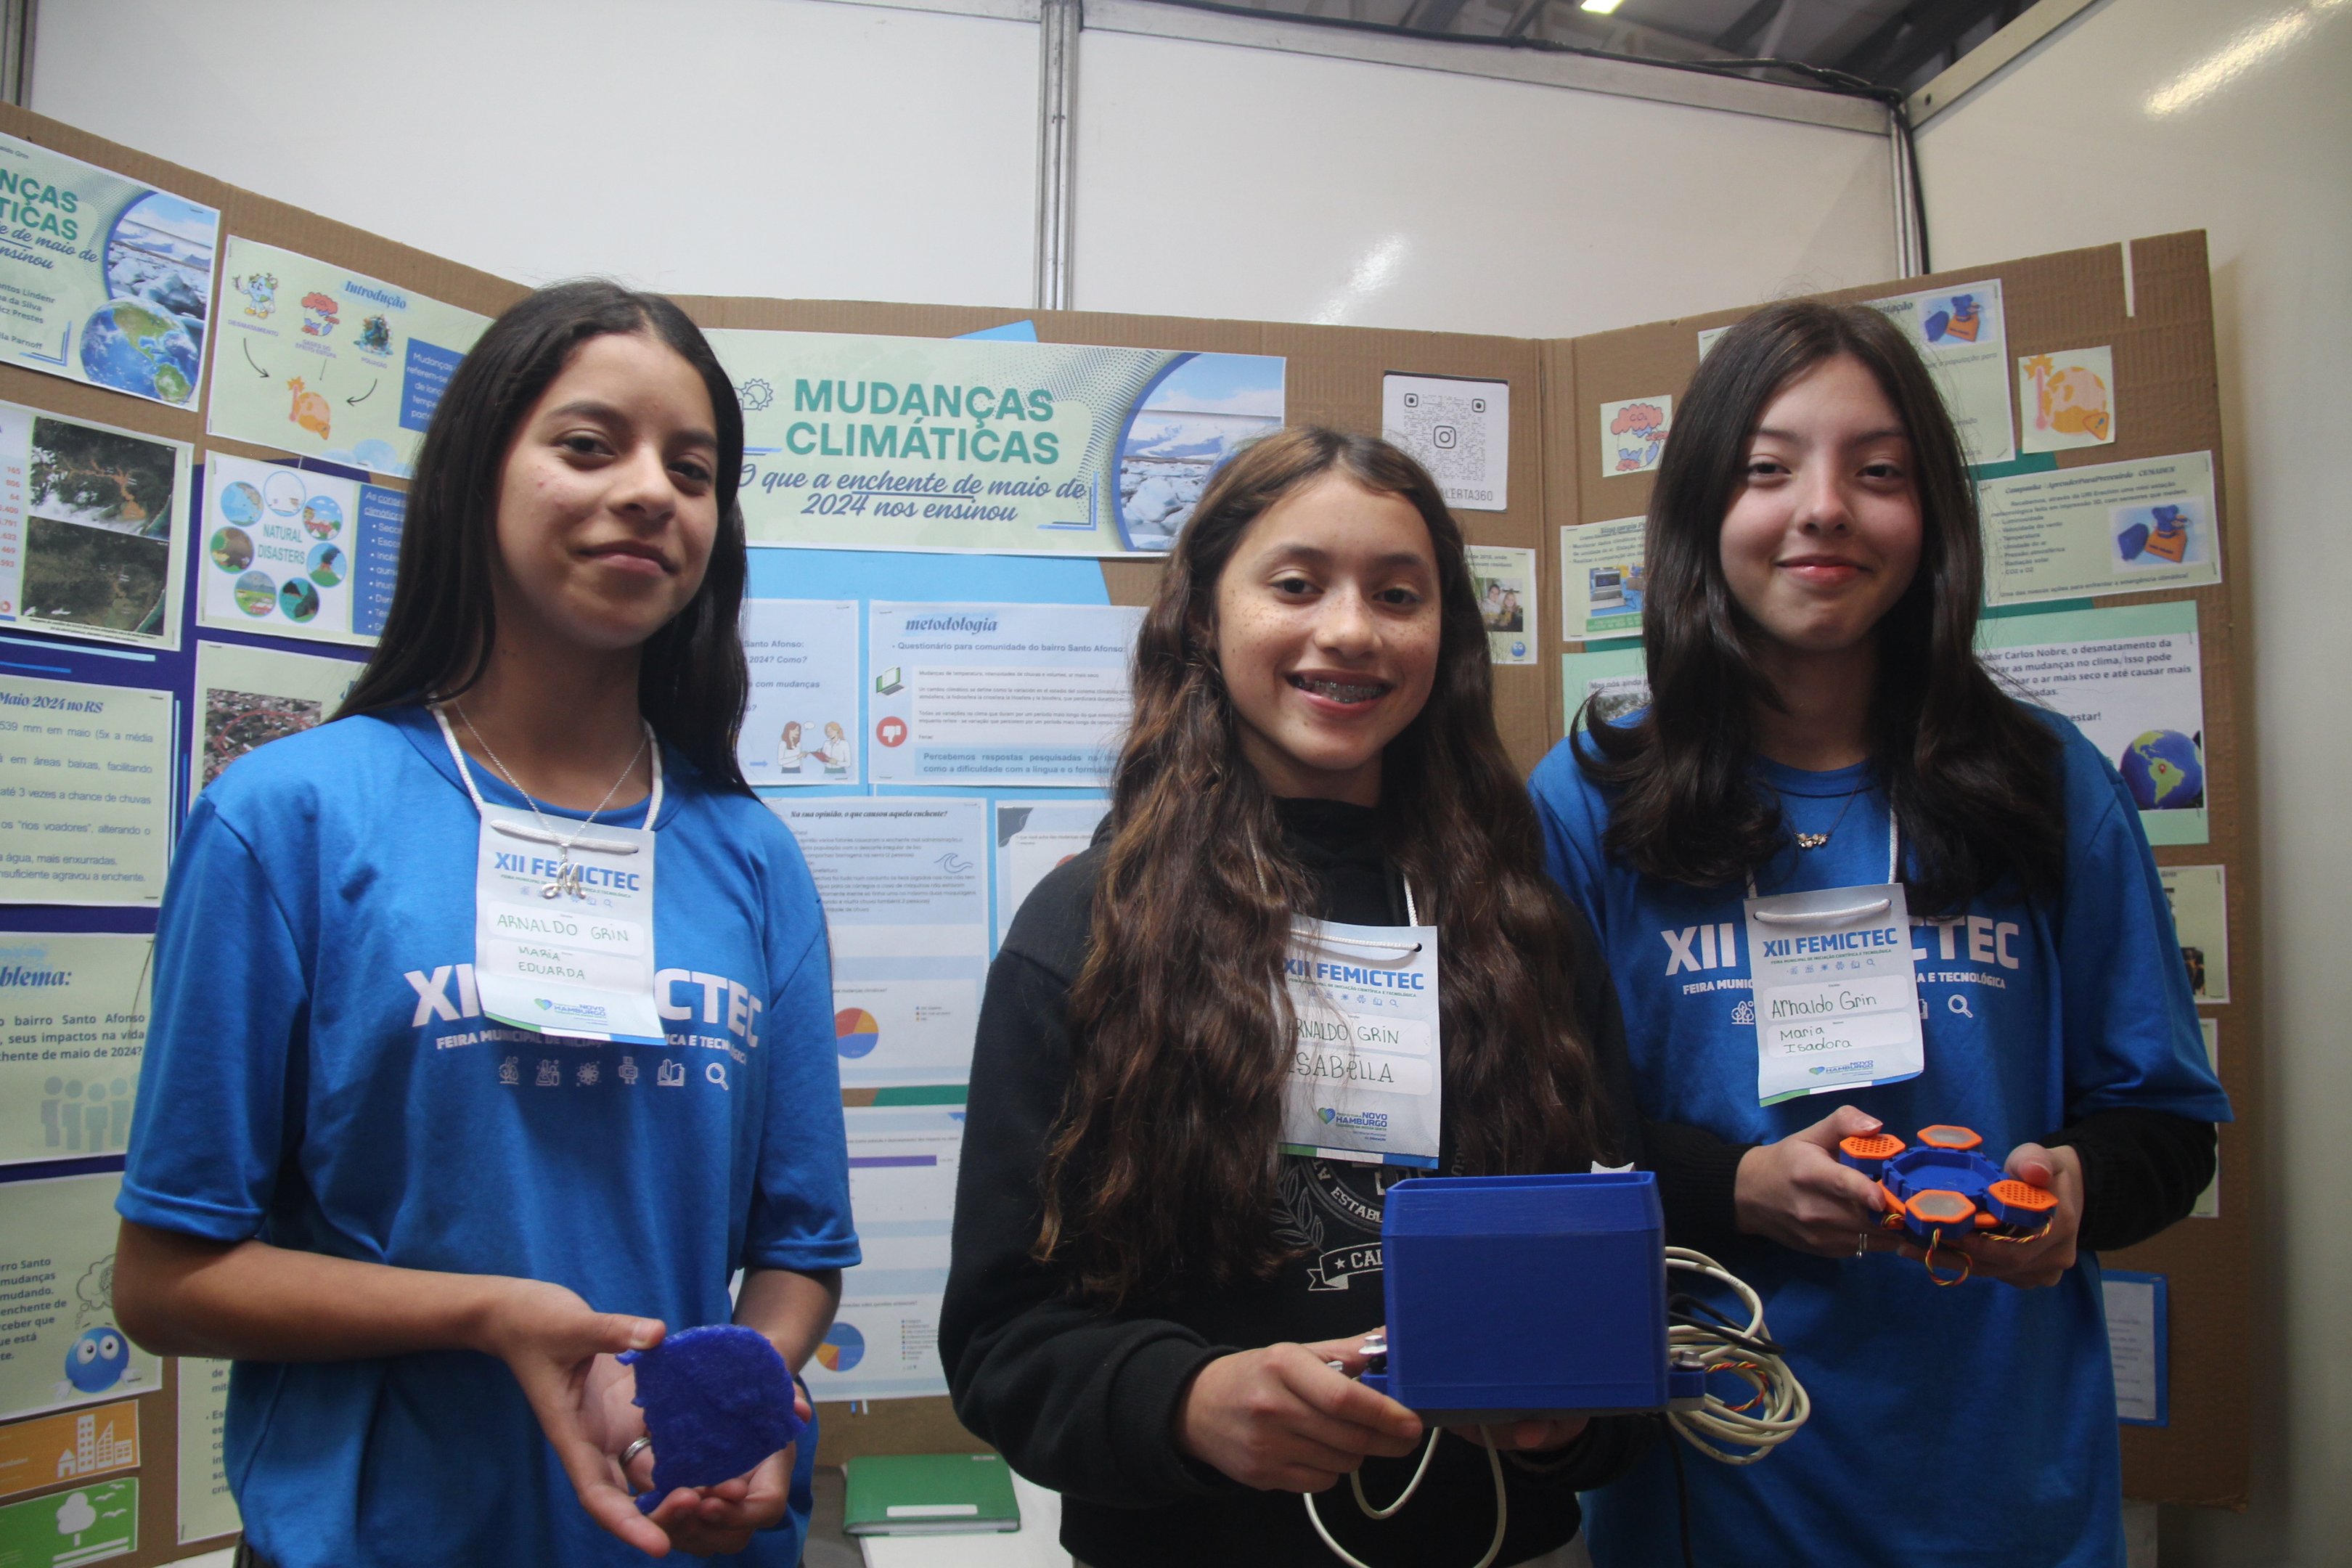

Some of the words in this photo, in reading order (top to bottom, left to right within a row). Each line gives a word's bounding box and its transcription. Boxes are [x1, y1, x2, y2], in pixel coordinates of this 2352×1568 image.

[11, 226, 33, 242] de
[36, 236, 75, 255] maio
[78, 247, 99, 263] de
[345, 280, 407, 309] Introdução
[413, 353, 453, 371] Mudanças
[415, 382, 425, 391] de
[795, 379, 1053, 429] MUDANÇAS
[786, 417, 1059, 465] CLIMÁTICAS
[762, 471, 809, 494] que
[812, 473, 832, 489] a
[836, 470, 947, 493] enchente
[952, 473, 984, 494] de
[987, 475, 1051, 497] maio
[1055, 478, 1087, 499] de
[366, 491, 377, 501] As
[801, 493, 870, 516] 2024
[873, 501, 918, 518] nos
[923, 498, 1018, 521] ensinou
[263, 523, 303, 543] NATURAL
[258, 544, 306, 565] DISASTERS
[905, 617, 997, 635] metodologia
[897, 642, 952, 651] Questionário
[975, 642, 1026, 651] comunidade
[2004, 650, 2034, 661] Carlos
[2036, 647, 2069, 657] Nobre,
[2081, 640, 2156, 653] desmatamento
[2159, 639, 2171, 648] da
[2025, 661, 2075, 671] mudanças
[2147, 653, 2172, 663] pode
[2054, 672, 2076, 682] mais
[2112, 669, 2128, 678] até
[2131, 666, 2160, 677] causar
[2167, 664, 2192, 674] mais
[0, 692, 29, 706] Maio
[32, 696, 65, 710] 2024
[66, 702, 83, 711] no
[83, 701, 104, 713] RS
[23, 724, 41, 733] mm
[67, 728, 91, 738] maio
[126, 732, 153, 743] média
[34, 756, 61, 767] áreas
[68, 759, 100, 770] baixas,
[107, 761, 152, 773] facilitando
[981, 754, 1023, 763] respostas
[1029, 754, 1082, 764] pesquisadas
[1032, 765, 1058, 775] língua
[0, 787, 15, 796] até
[19, 788, 25, 796] 3
[28, 790, 56, 799] vezes
[68, 791, 102, 801] chance
[105, 793, 117, 802] de
[119, 793, 151, 804] chuvas
[817, 809, 844, 819] opinião,
[890, 810, 913, 820] aquela
[97, 825, 141, 835] alterando
[6, 852, 33, 864] água,
[37, 854, 60, 863] mais
[62, 855, 118, 865] enxurradas.
[494, 852, 524, 872] XII
[52, 871, 91, 882] agravou
[102, 873, 146, 882] enchente.
[497, 915, 578, 936] ARNALDO
[1660, 923, 1736, 976] XII
[1763, 939, 1791, 957] XII
[1795, 928, 1898, 954] FEMICTEC
[518, 962, 585, 980] EDUARDA
[1317, 963, 1424, 990] FEMICTEC
[1683, 981, 1715, 995] FEIRA
[1928, 972, 1935, 982] E
[1937, 972, 2006, 989] TECNOLÓGICA
[1772, 994, 1833, 1018] Arnaldo
[1839, 991, 1877, 1010] Grin
[15, 1016, 53, 1026] bairro
[62, 1015, 97, 1024] Santo
[105, 1013, 144, 1024] Afonso
[8, 1034, 36, 1044] seus
[41, 1032, 97, 1045] impactos
[121, 1030, 144, 1040] vida
[436, 1032, 478, 1050] FEIRA
[480, 1029, 542, 1044] MUNICIPAL
[689, 1034, 697, 1046] E
[1780, 1026, 1824, 1040] Maria
[42, 1050, 57, 1060] de
[60, 1049, 90, 1059] maio
[94, 1048, 107, 1057] de
[111, 1046, 142, 1056] 2024?
[1784, 1037, 1852, 1053] Isadora
[1336, 1116, 1387, 1127] HAMBURGO
[1362, 1111, 1387, 1120] NOVO
[20, 1259, 51, 1269] Santo
[0, 1273, 55, 1286] mudanças
[0, 1287, 54, 1301] mudando.
[1, 1302, 51, 1316] enchente
[54, 1299, 67, 1308] de
[35, 1317, 55, 1327] que
[14, 1332, 37, 1344] está
